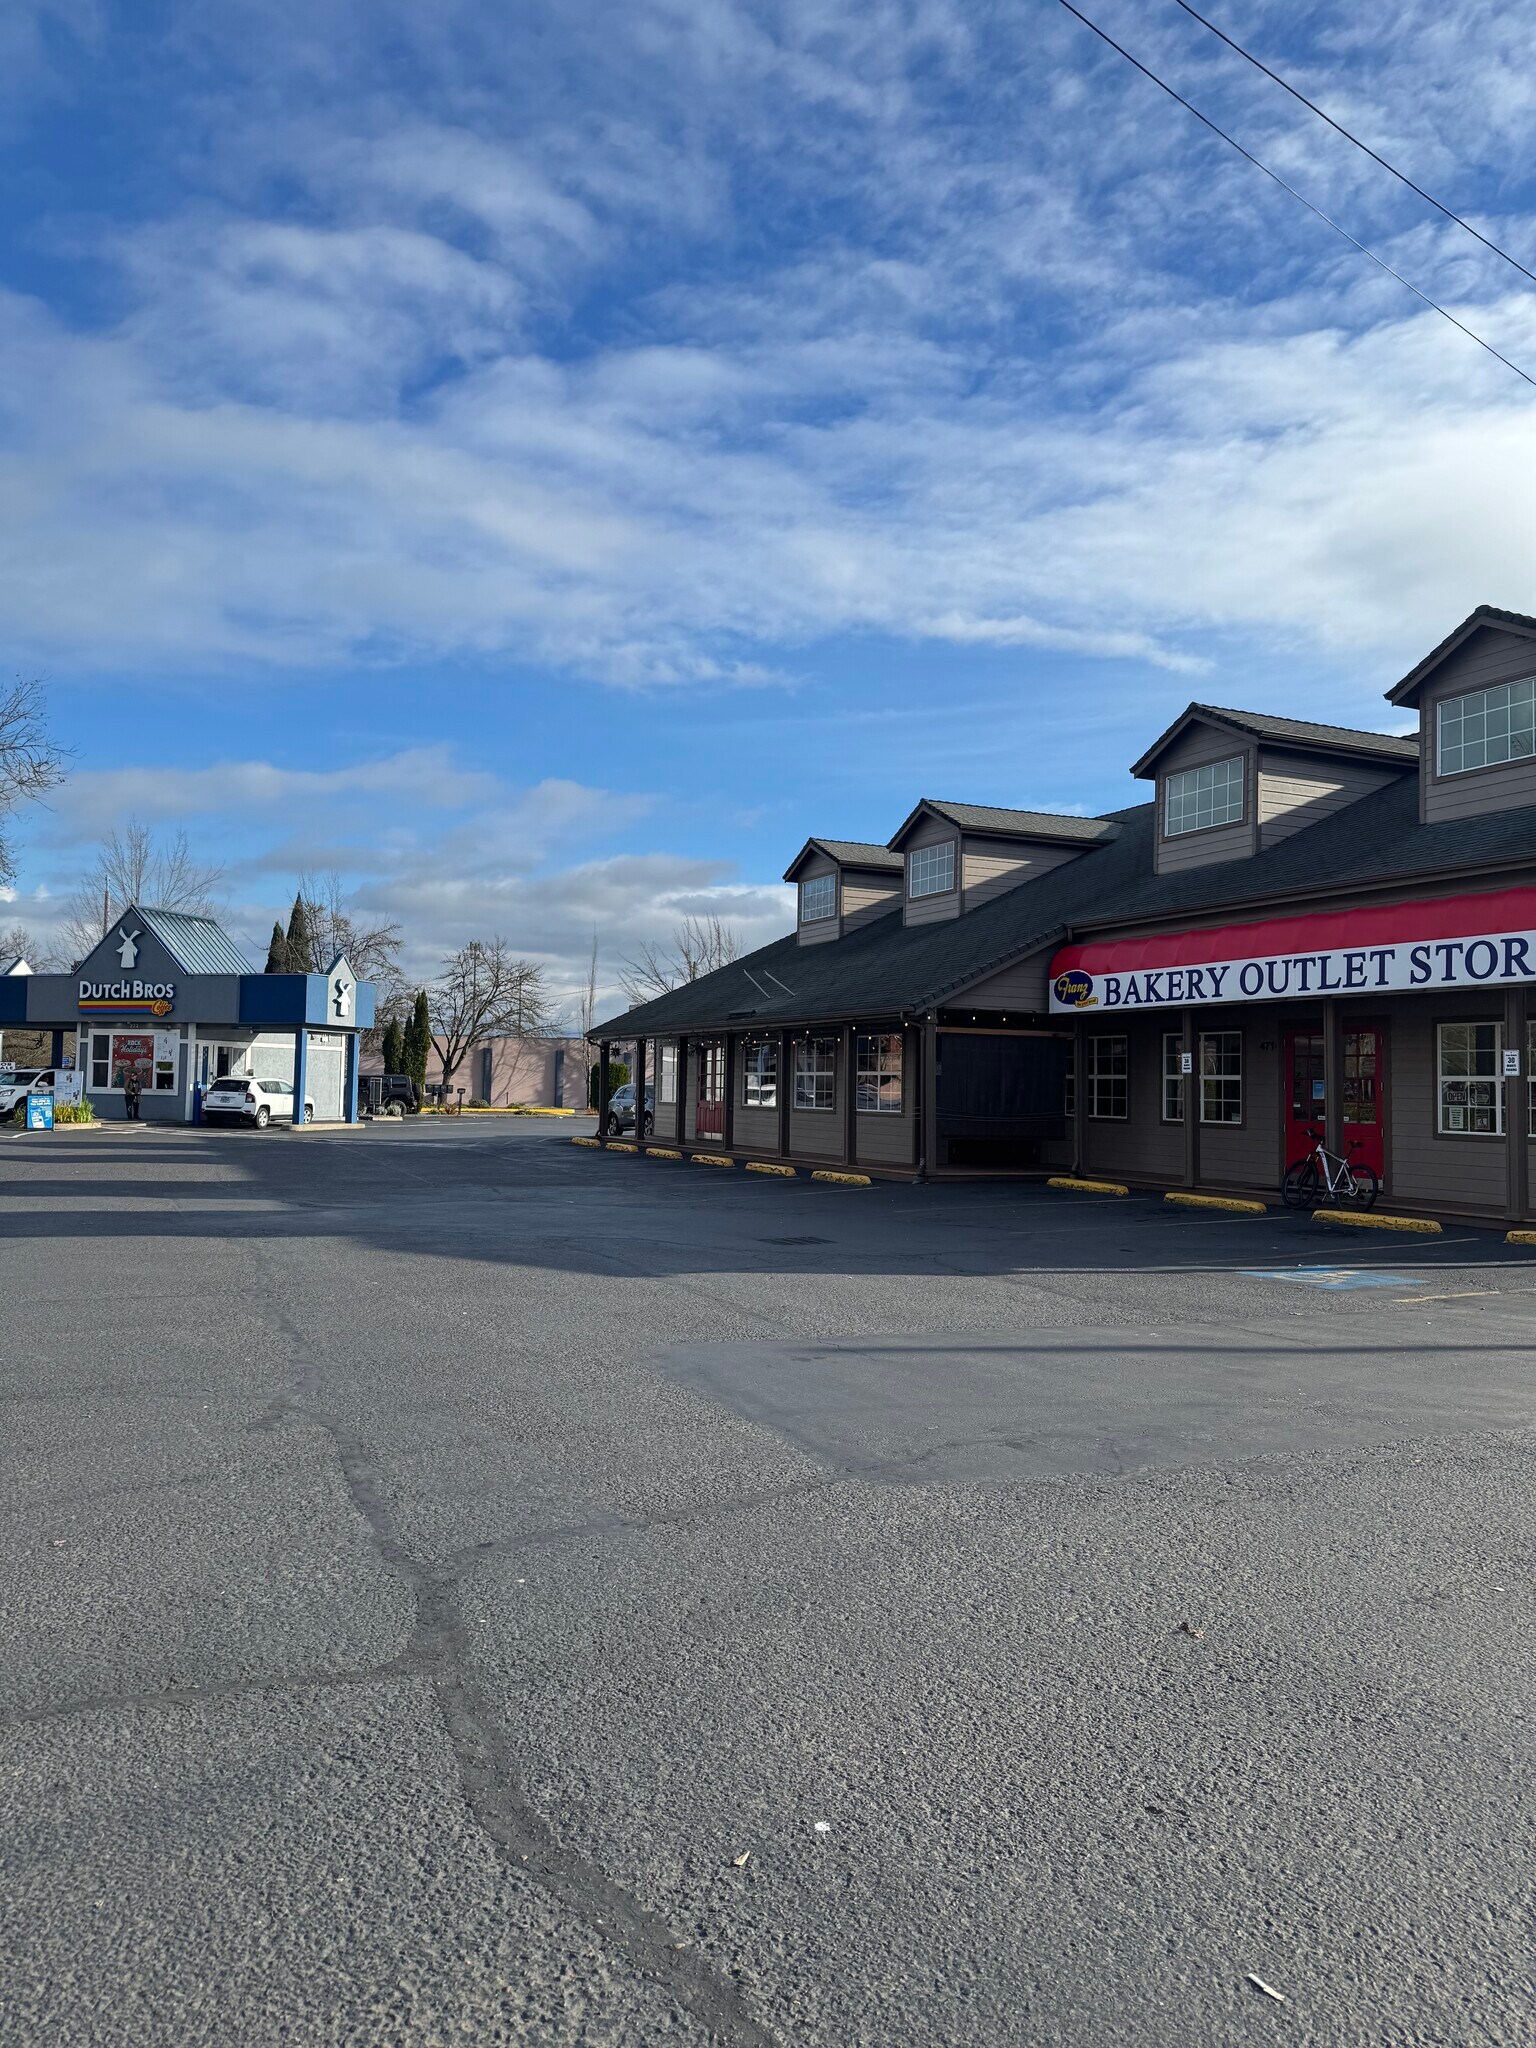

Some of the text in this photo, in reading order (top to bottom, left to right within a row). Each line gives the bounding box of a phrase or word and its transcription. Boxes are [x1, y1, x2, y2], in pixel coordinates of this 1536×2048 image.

[1104, 937, 1535, 1006] BAKERY OUTLET STOR
[132, 980, 174, 999] BROS
[1057, 977, 1088, 1001] Franz
[1448, 1093, 1466, 1101] OPEN
